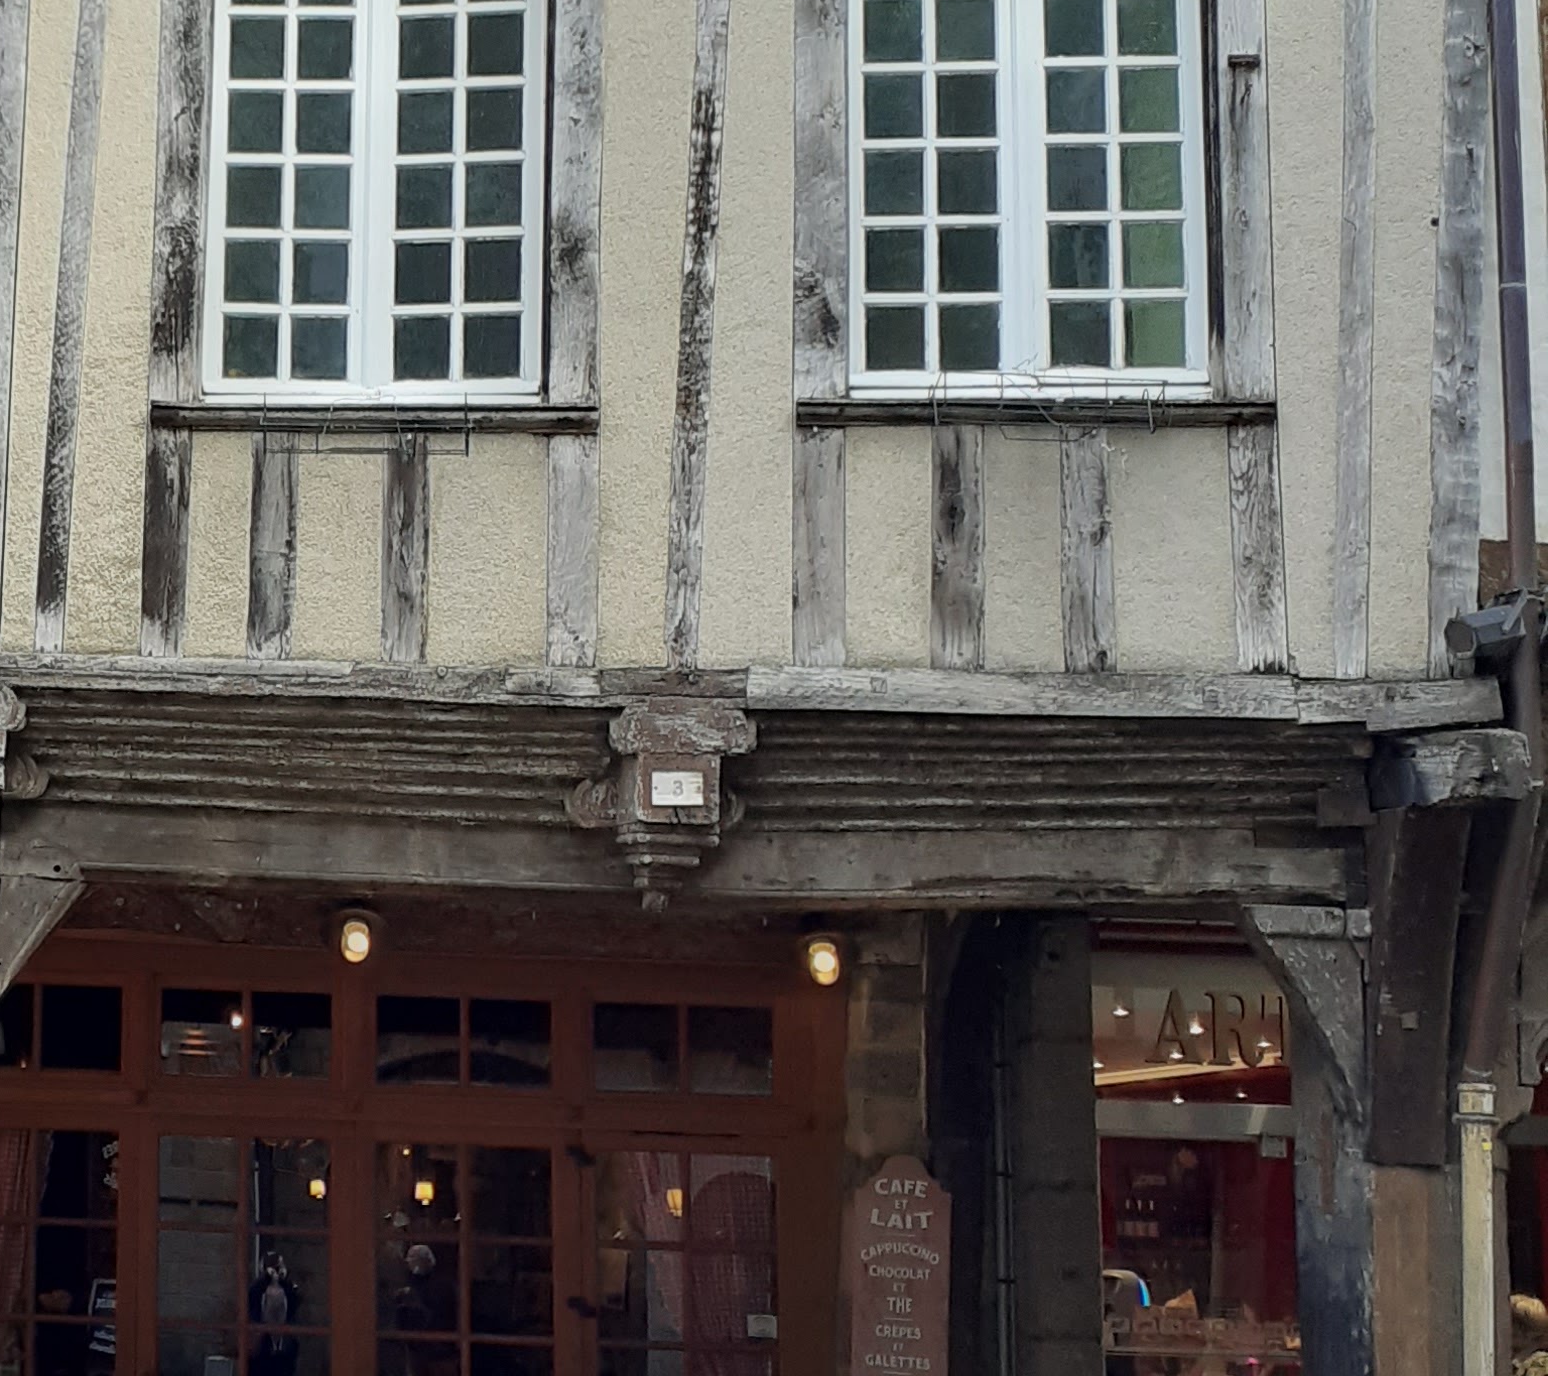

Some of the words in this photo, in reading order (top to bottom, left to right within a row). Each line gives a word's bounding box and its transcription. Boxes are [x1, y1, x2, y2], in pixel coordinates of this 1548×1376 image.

[672, 780, 684, 797] 3
[874, 1177, 929, 1198] CAFE
[894, 1199, 909, 1210] ET
[870, 1208, 934, 1229] LAIT
[860, 1241, 940, 1265] CAPPUCCINO
[869, 1264, 931, 1280] CHOCOLAT
[886, 1296, 913, 1313] THE
[865, 1353, 930, 1371] GALETTES
